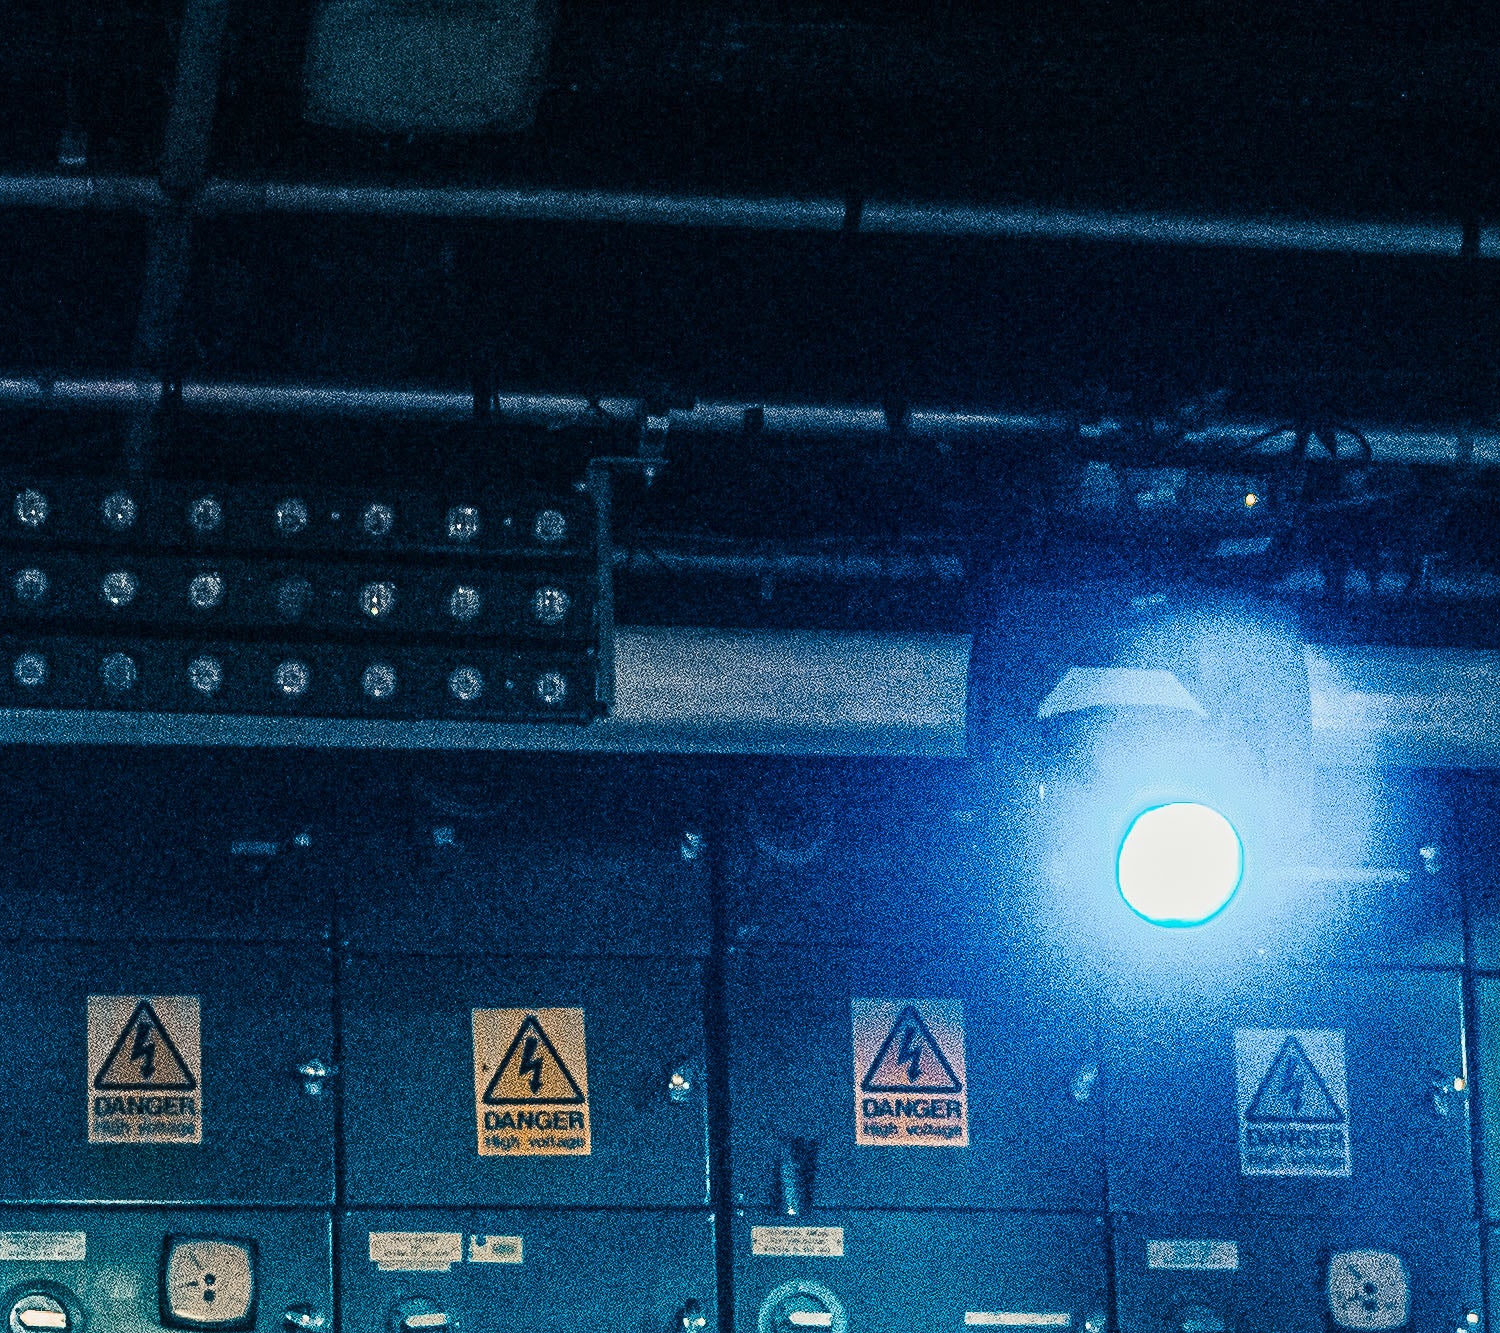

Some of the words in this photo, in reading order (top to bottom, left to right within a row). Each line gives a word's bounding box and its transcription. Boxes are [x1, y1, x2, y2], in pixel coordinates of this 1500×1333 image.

[94, 1097, 195, 1116] DANGER
[862, 1098, 962, 1119] DANGER
[484, 1111, 585, 1130] DANGER
[485, 1135, 521, 1150] High
[529, 1135, 586, 1150] voltage
